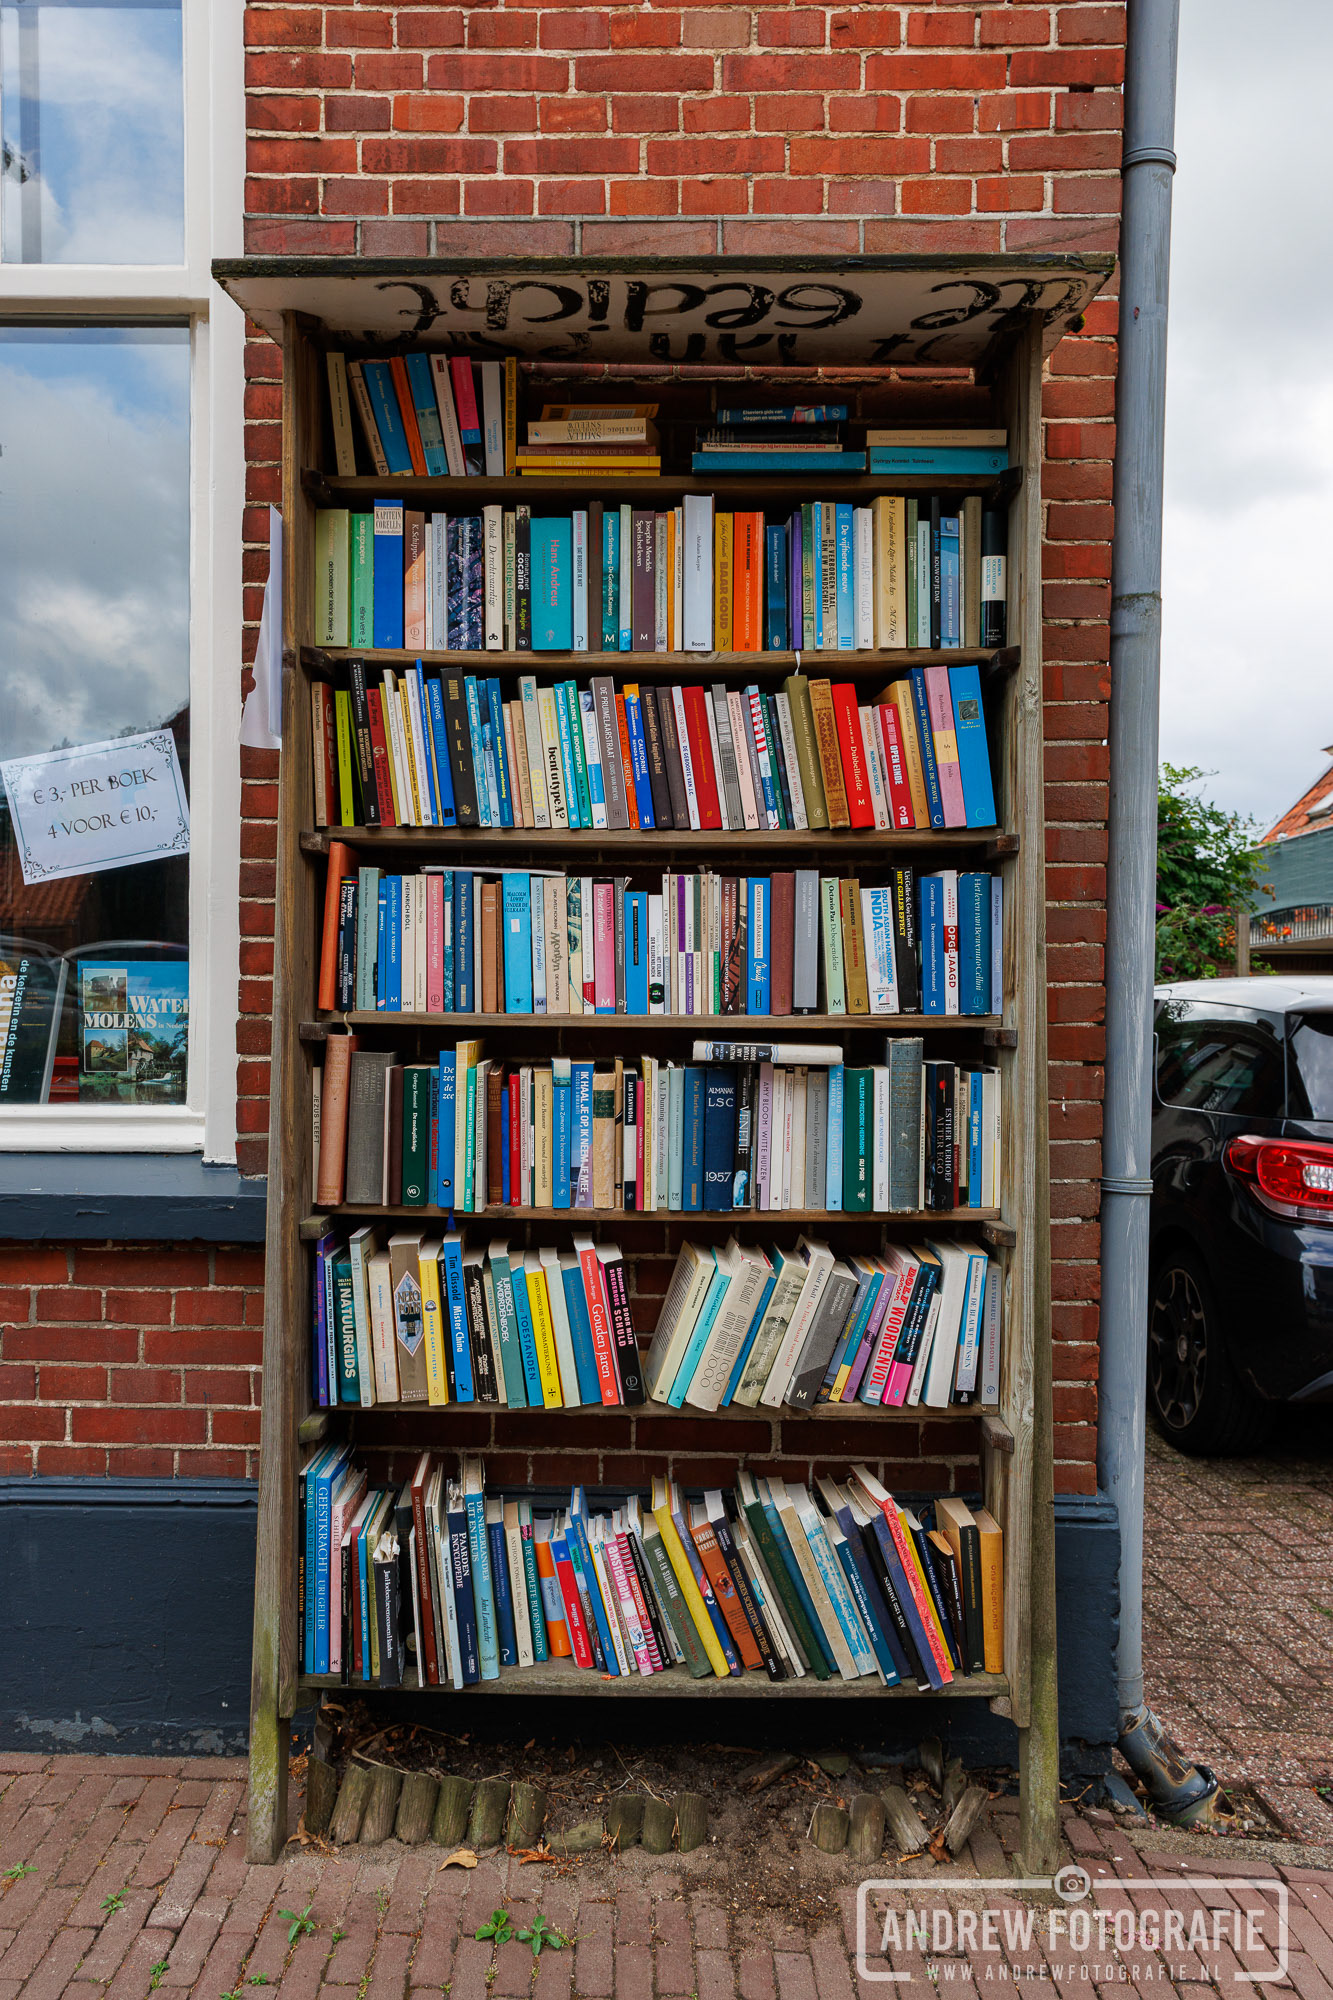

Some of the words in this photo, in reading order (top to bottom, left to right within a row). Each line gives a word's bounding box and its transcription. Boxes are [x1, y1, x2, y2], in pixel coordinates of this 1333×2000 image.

[375, 510, 402, 520] KAPITEIN
[489, 520, 497, 538] Potok
[841, 525, 849, 535] De
[550, 540, 560, 563] Hans
[840, 537, 850, 571] vijftiende
[550, 566, 560, 606] Andreus
[720, 562, 728, 594] BAAR
[720, 597, 728, 629] GOUD
[568, 687, 577, 721] MIGRAINE
[574, 735, 582, 773] HOOFDPIJN
[601, 697, 614, 758] PRUIMELAARSTRAAT
[762, 705, 770, 734] RONDOM
[766, 737, 774, 756] DAUM
[850, 746, 863, 791] Dubbelliefde
[890, 745, 901, 763] OPEN
[70, 778, 104, 798] PER
[110, 767, 158, 791] BOEK
[531, 770, 545, 808] GEEST
[892, 765, 903, 784] EINDE
[47, 824, 58, 839] 4
[60, 812, 118, 837] VOOR
[119, 808, 133, 825] €
[871, 890, 883, 931] INDIA
[20, 960, 30, 973] de
[551, 932, 563, 971] Montyn
[948, 926, 956, 988] OPGEJAAGD
[13, 976, 27, 1016] keizerin
[11, 1018, 19, 1031] en
[84, 1013, 157, 1028] MOLENS
[8, 1033, 18, 1048] de
[0, 1049, 15, 1091] kunsten
[581, 1081, 589, 1103] HAAL
[658, 1094, 666, 1122] Dunning
[581, 1104, 589, 1114] JE
[580, 1129, 589, 1139] IK
[580, 1175, 589, 1192] MEE
[706, 1172, 731, 1182] 1957
[449, 1256, 457, 1269] Tim
[450, 1271, 461, 1300] Clissold
[501, 1277, 513, 1316] JURIDISCH
[534, 1277, 544, 1317] HISTORISCHE
[453, 1306, 462, 1330] Mister
[497, 1281, 509, 1342] WOORDENBOEK
[340, 1288, 355, 1379] NATUURGIDS
[456, 1332, 464, 1352] China
[591, 1304, 605, 1348] Gouden
[598, 1350, 611, 1378] jaren
[613, 1310, 626, 1347] SCHULD
[520, 1316, 536, 1380] TOESTANDEN
[538, 1318, 552, 1376] INFORMATIEKUNDE
[870, 1306, 905, 1386] WOORDENVOL
[700, 1354, 720, 1388] 2000
[467, 1502, 475, 1518] UIT
[317, 1487, 328, 1575] GEESTKRACHT
[451, 1533, 463, 1589] ENCYCLOPEDIE
[459, 1532, 469, 1577] PAARDEN
[470, 1536, 479, 1562] THUIS
[477, 1516, 489, 1582] NEDERLANDER
[524, 1546, 532, 1556] DE
[317, 1580, 325, 1595] URI
[526, 1557, 537, 1599] COMPLETE
[629, 1577, 645, 1616] AMSTERDAM
[317, 1598, 325, 1630] GELLER
[530, 1600, 543, 1654] BLOEMENGIDS
